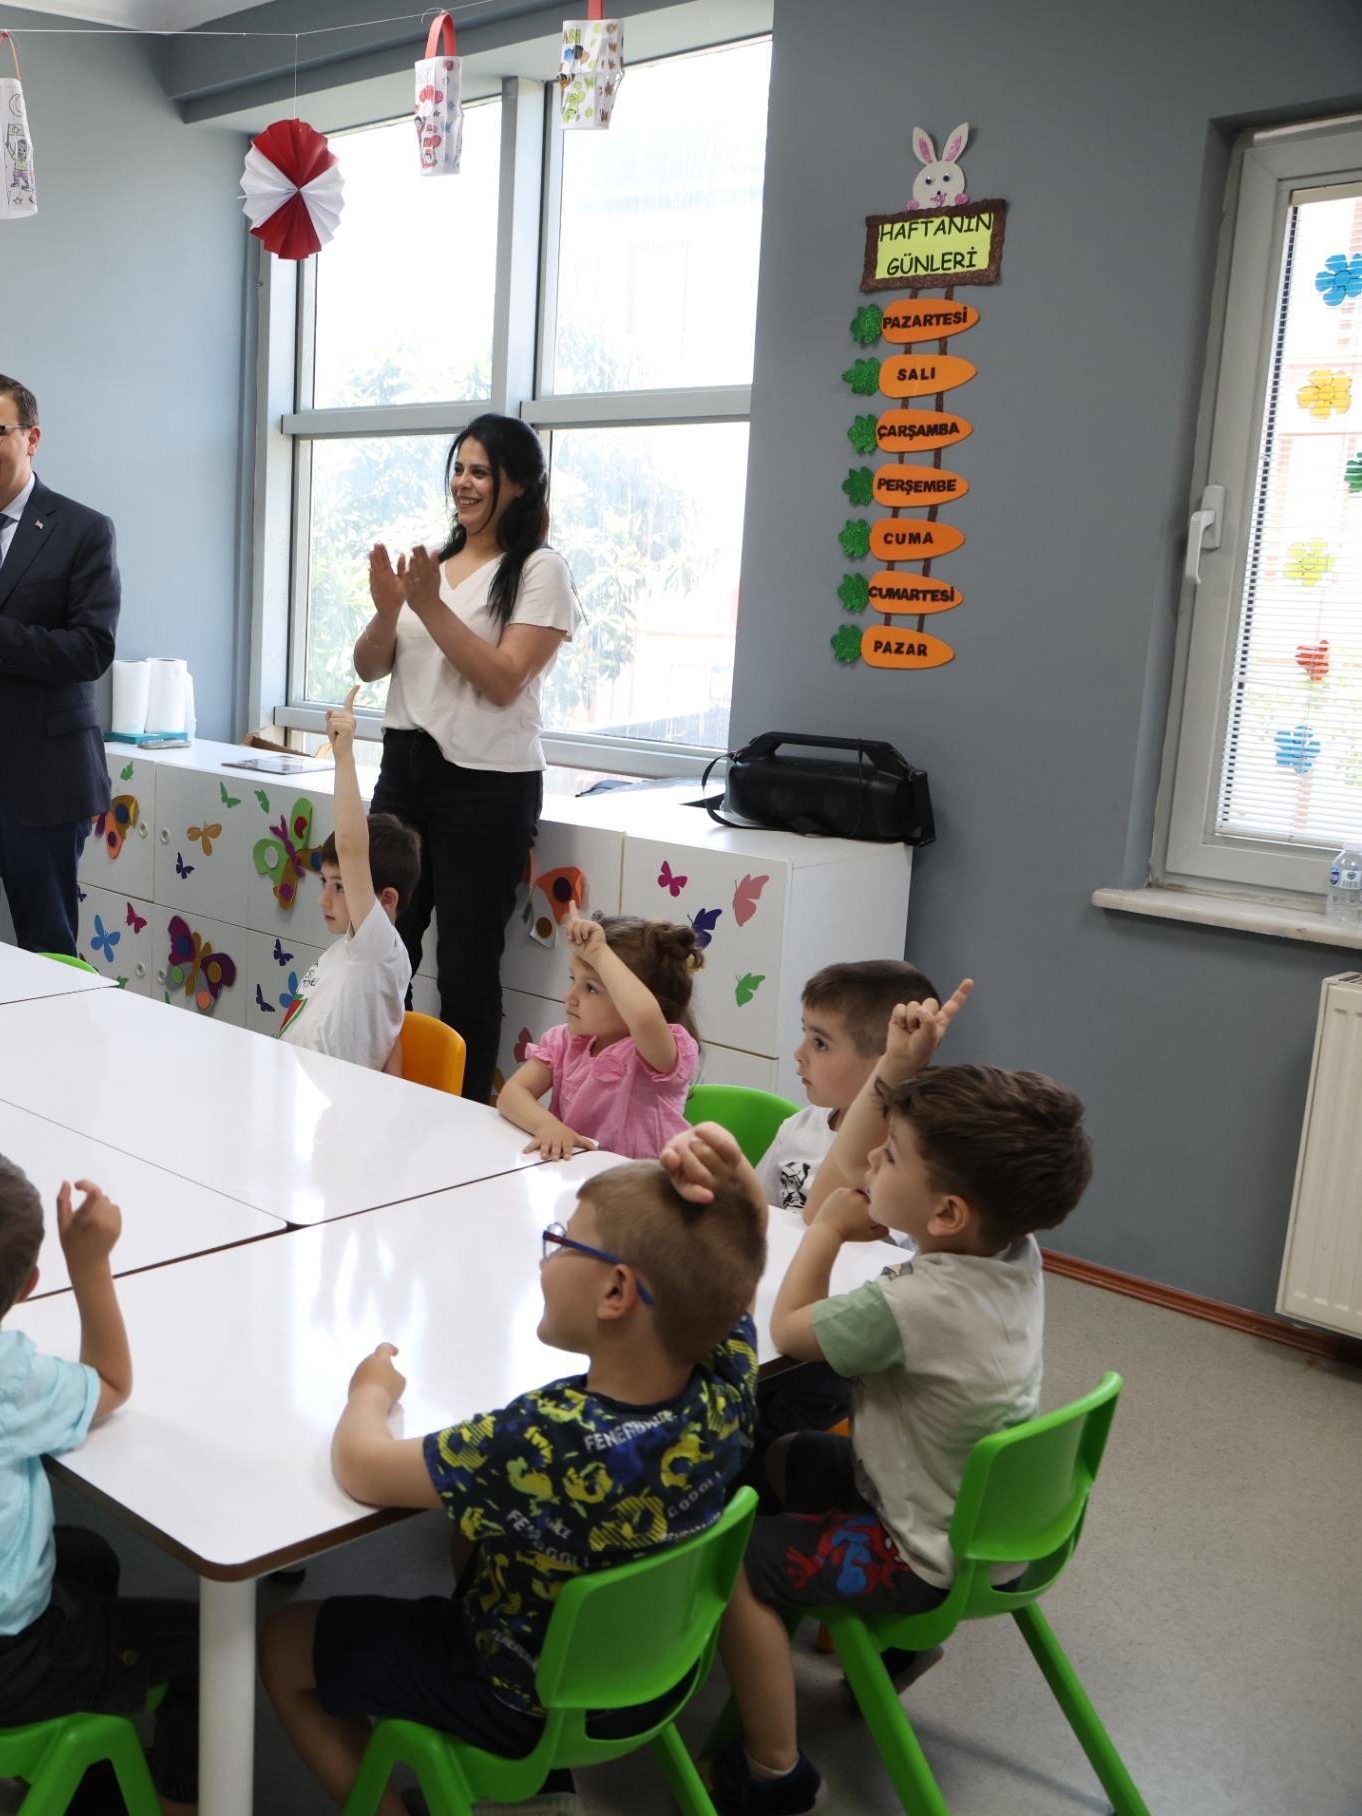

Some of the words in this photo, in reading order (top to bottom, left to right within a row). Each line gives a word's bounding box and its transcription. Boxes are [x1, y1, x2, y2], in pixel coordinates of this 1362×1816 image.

[879, 212, 993, 242] HAFTANIN
[887, 247, 977, 276] GÜNLERİ
[882, 307, 968, 329] PAZARTESİ
[896, 367, 936, 381] SALI
[877, 422, 960, 440] ÇARŞAMBA
[877, 478, 957, 495] PERŞEMBE
[883, 532, 934, 545] CUMA
[868, 586, 955, 602] CUMARTESİ
[873, 640, 928, 657] PAZAR
